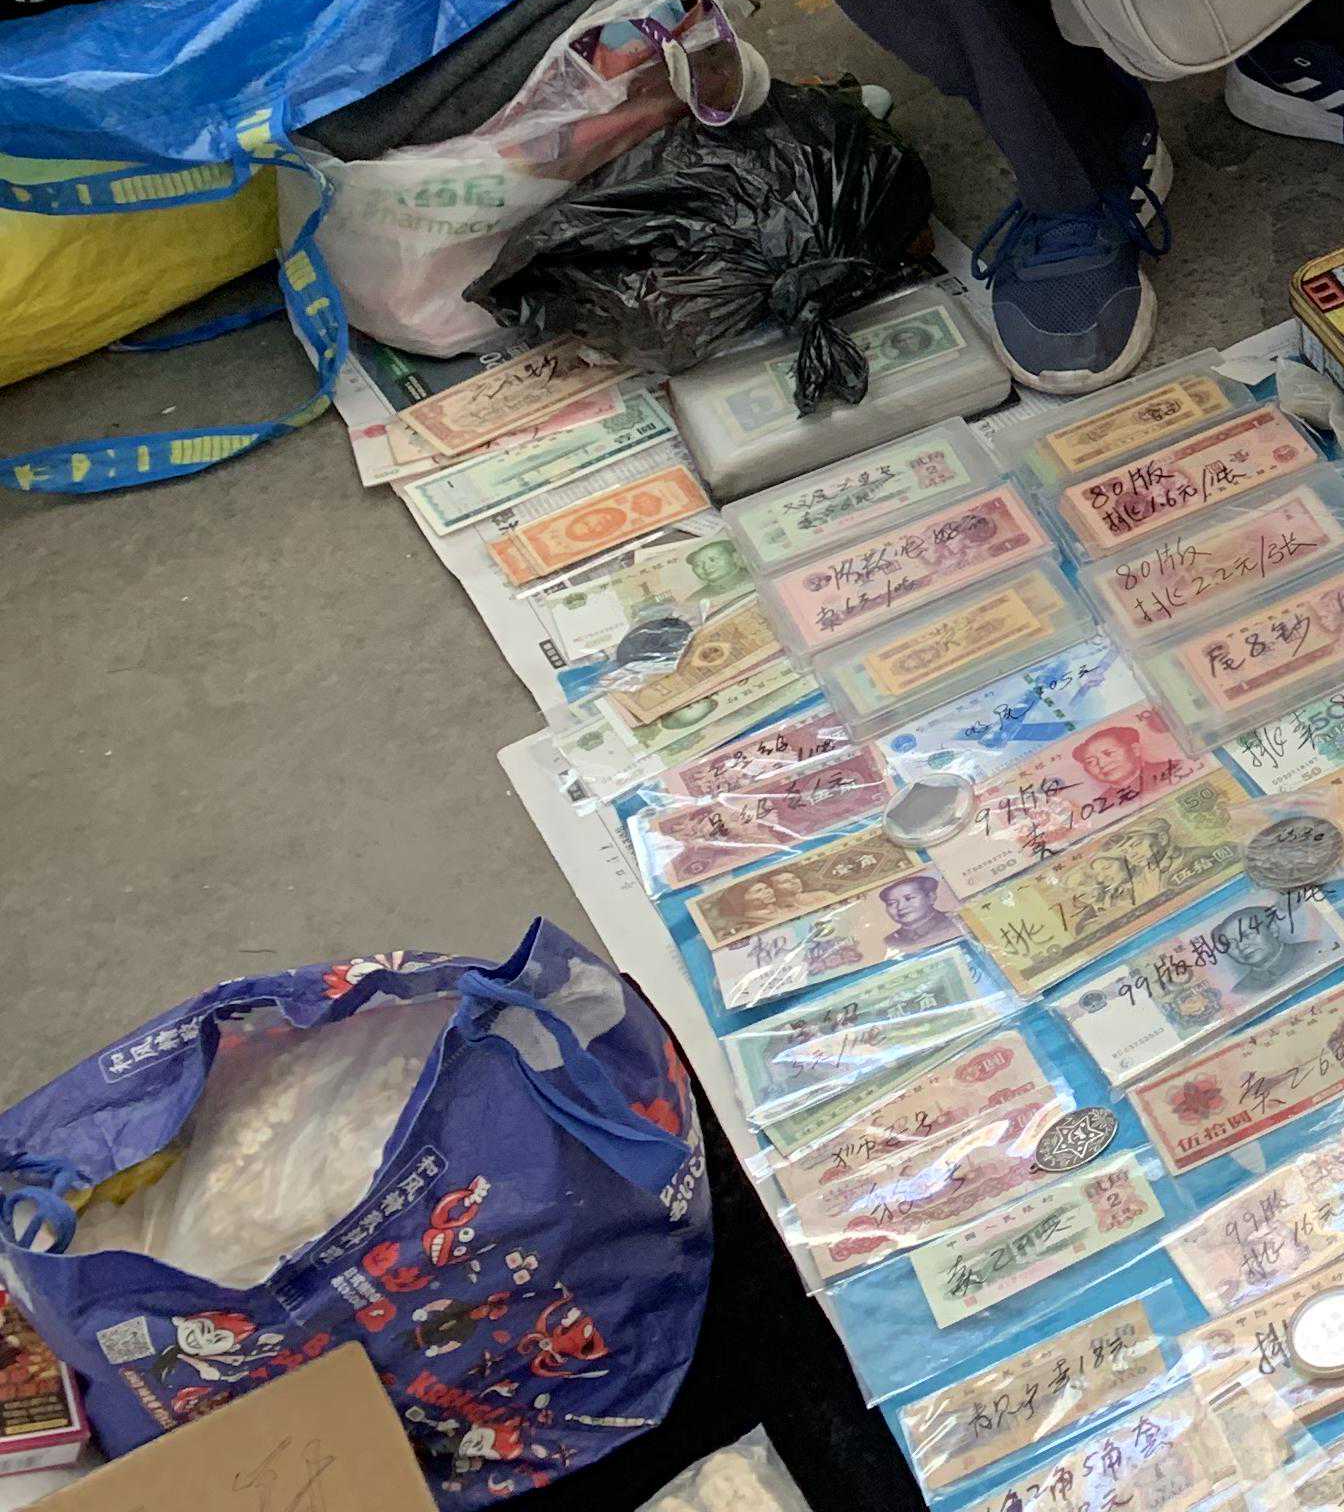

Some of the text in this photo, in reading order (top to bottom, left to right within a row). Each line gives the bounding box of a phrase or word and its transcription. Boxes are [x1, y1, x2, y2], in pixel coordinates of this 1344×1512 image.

[1089, 459, 1175, 509] 80版
[1116, 536, 1212, 590] 80版
[1182, 787, 1215, 812] 50
[1170, 846, 1235, 886] 伍拾圆
